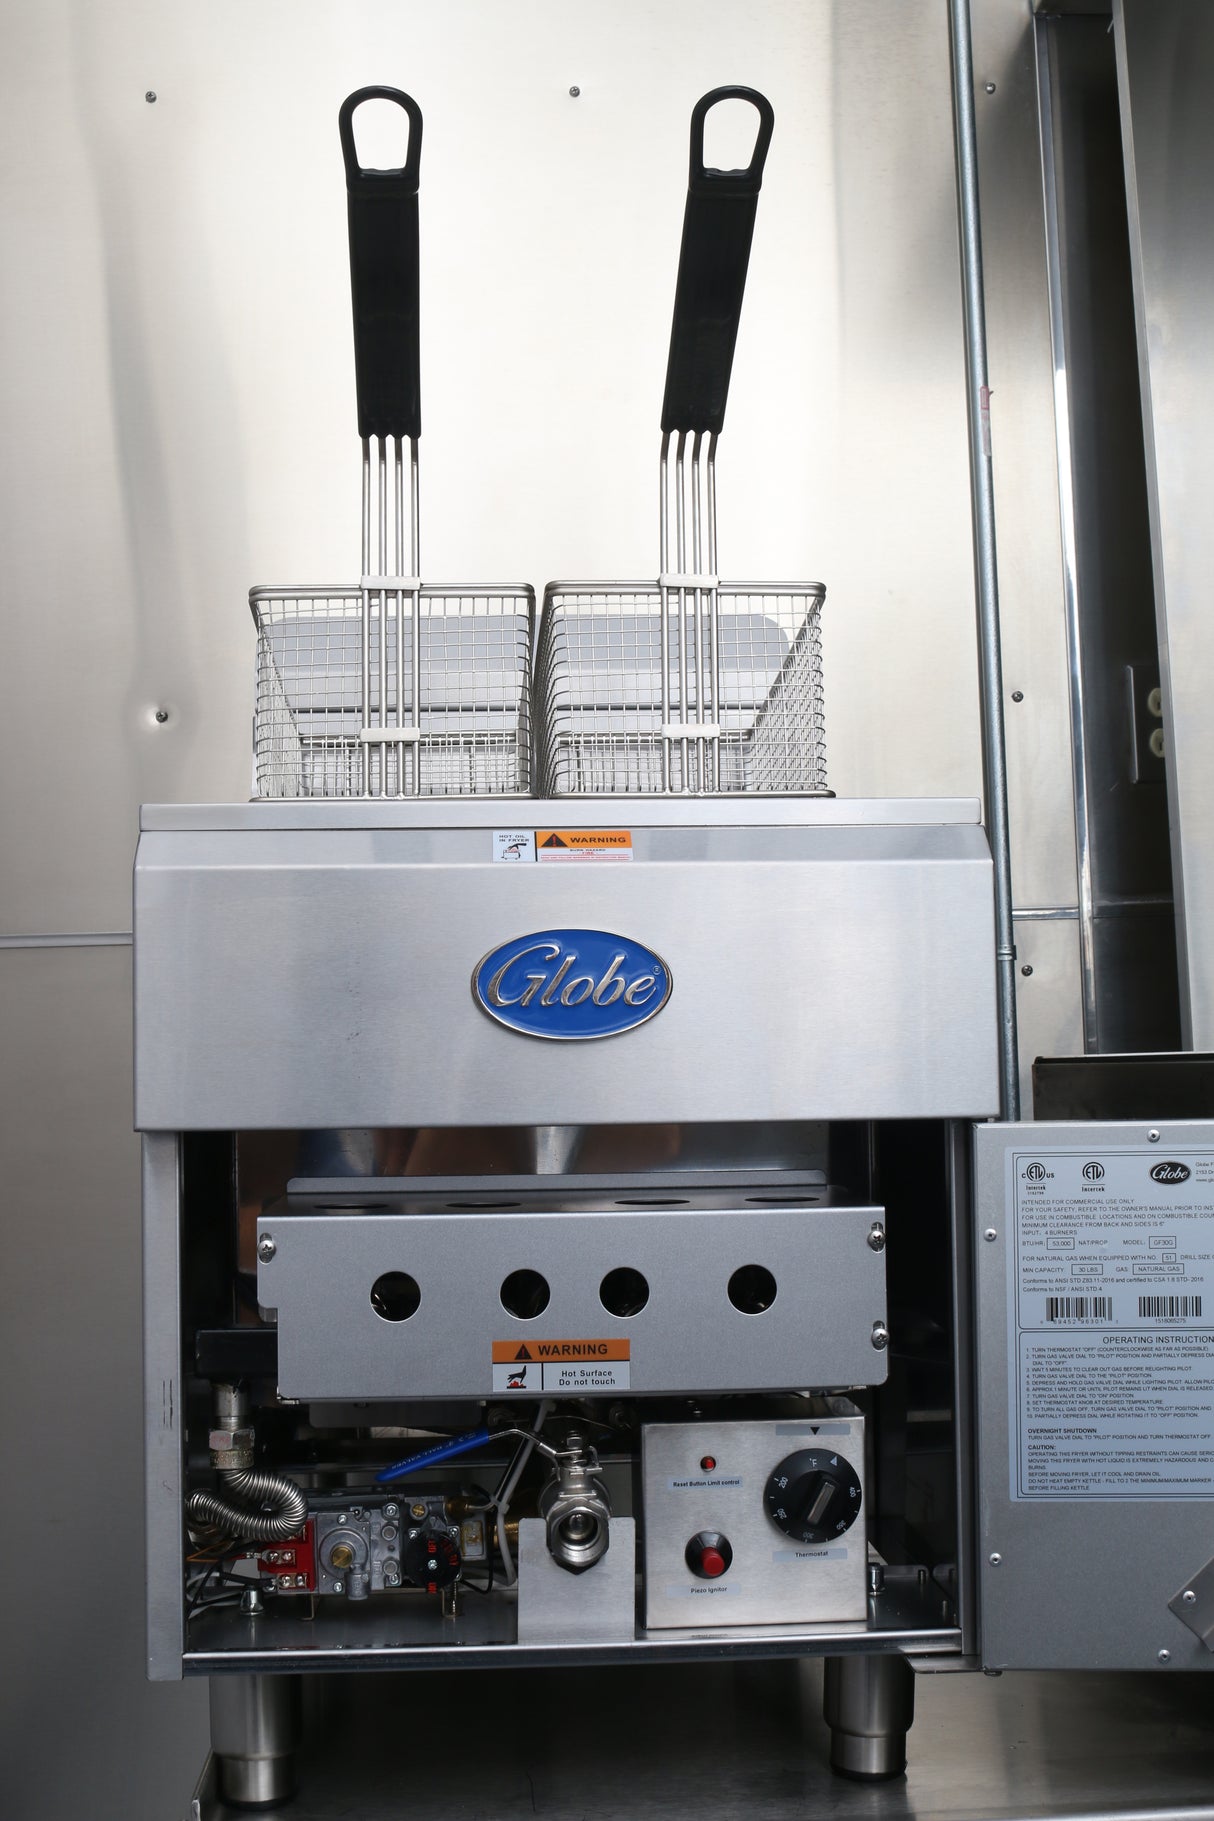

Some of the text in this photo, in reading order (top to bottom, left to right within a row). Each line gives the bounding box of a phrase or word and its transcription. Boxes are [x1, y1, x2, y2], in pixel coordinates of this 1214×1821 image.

[488, 944, 657, 1007] Globe
[1152, 1164, 1188, 1179] Globe
[538, 1344, 608, 1356] WARNING
